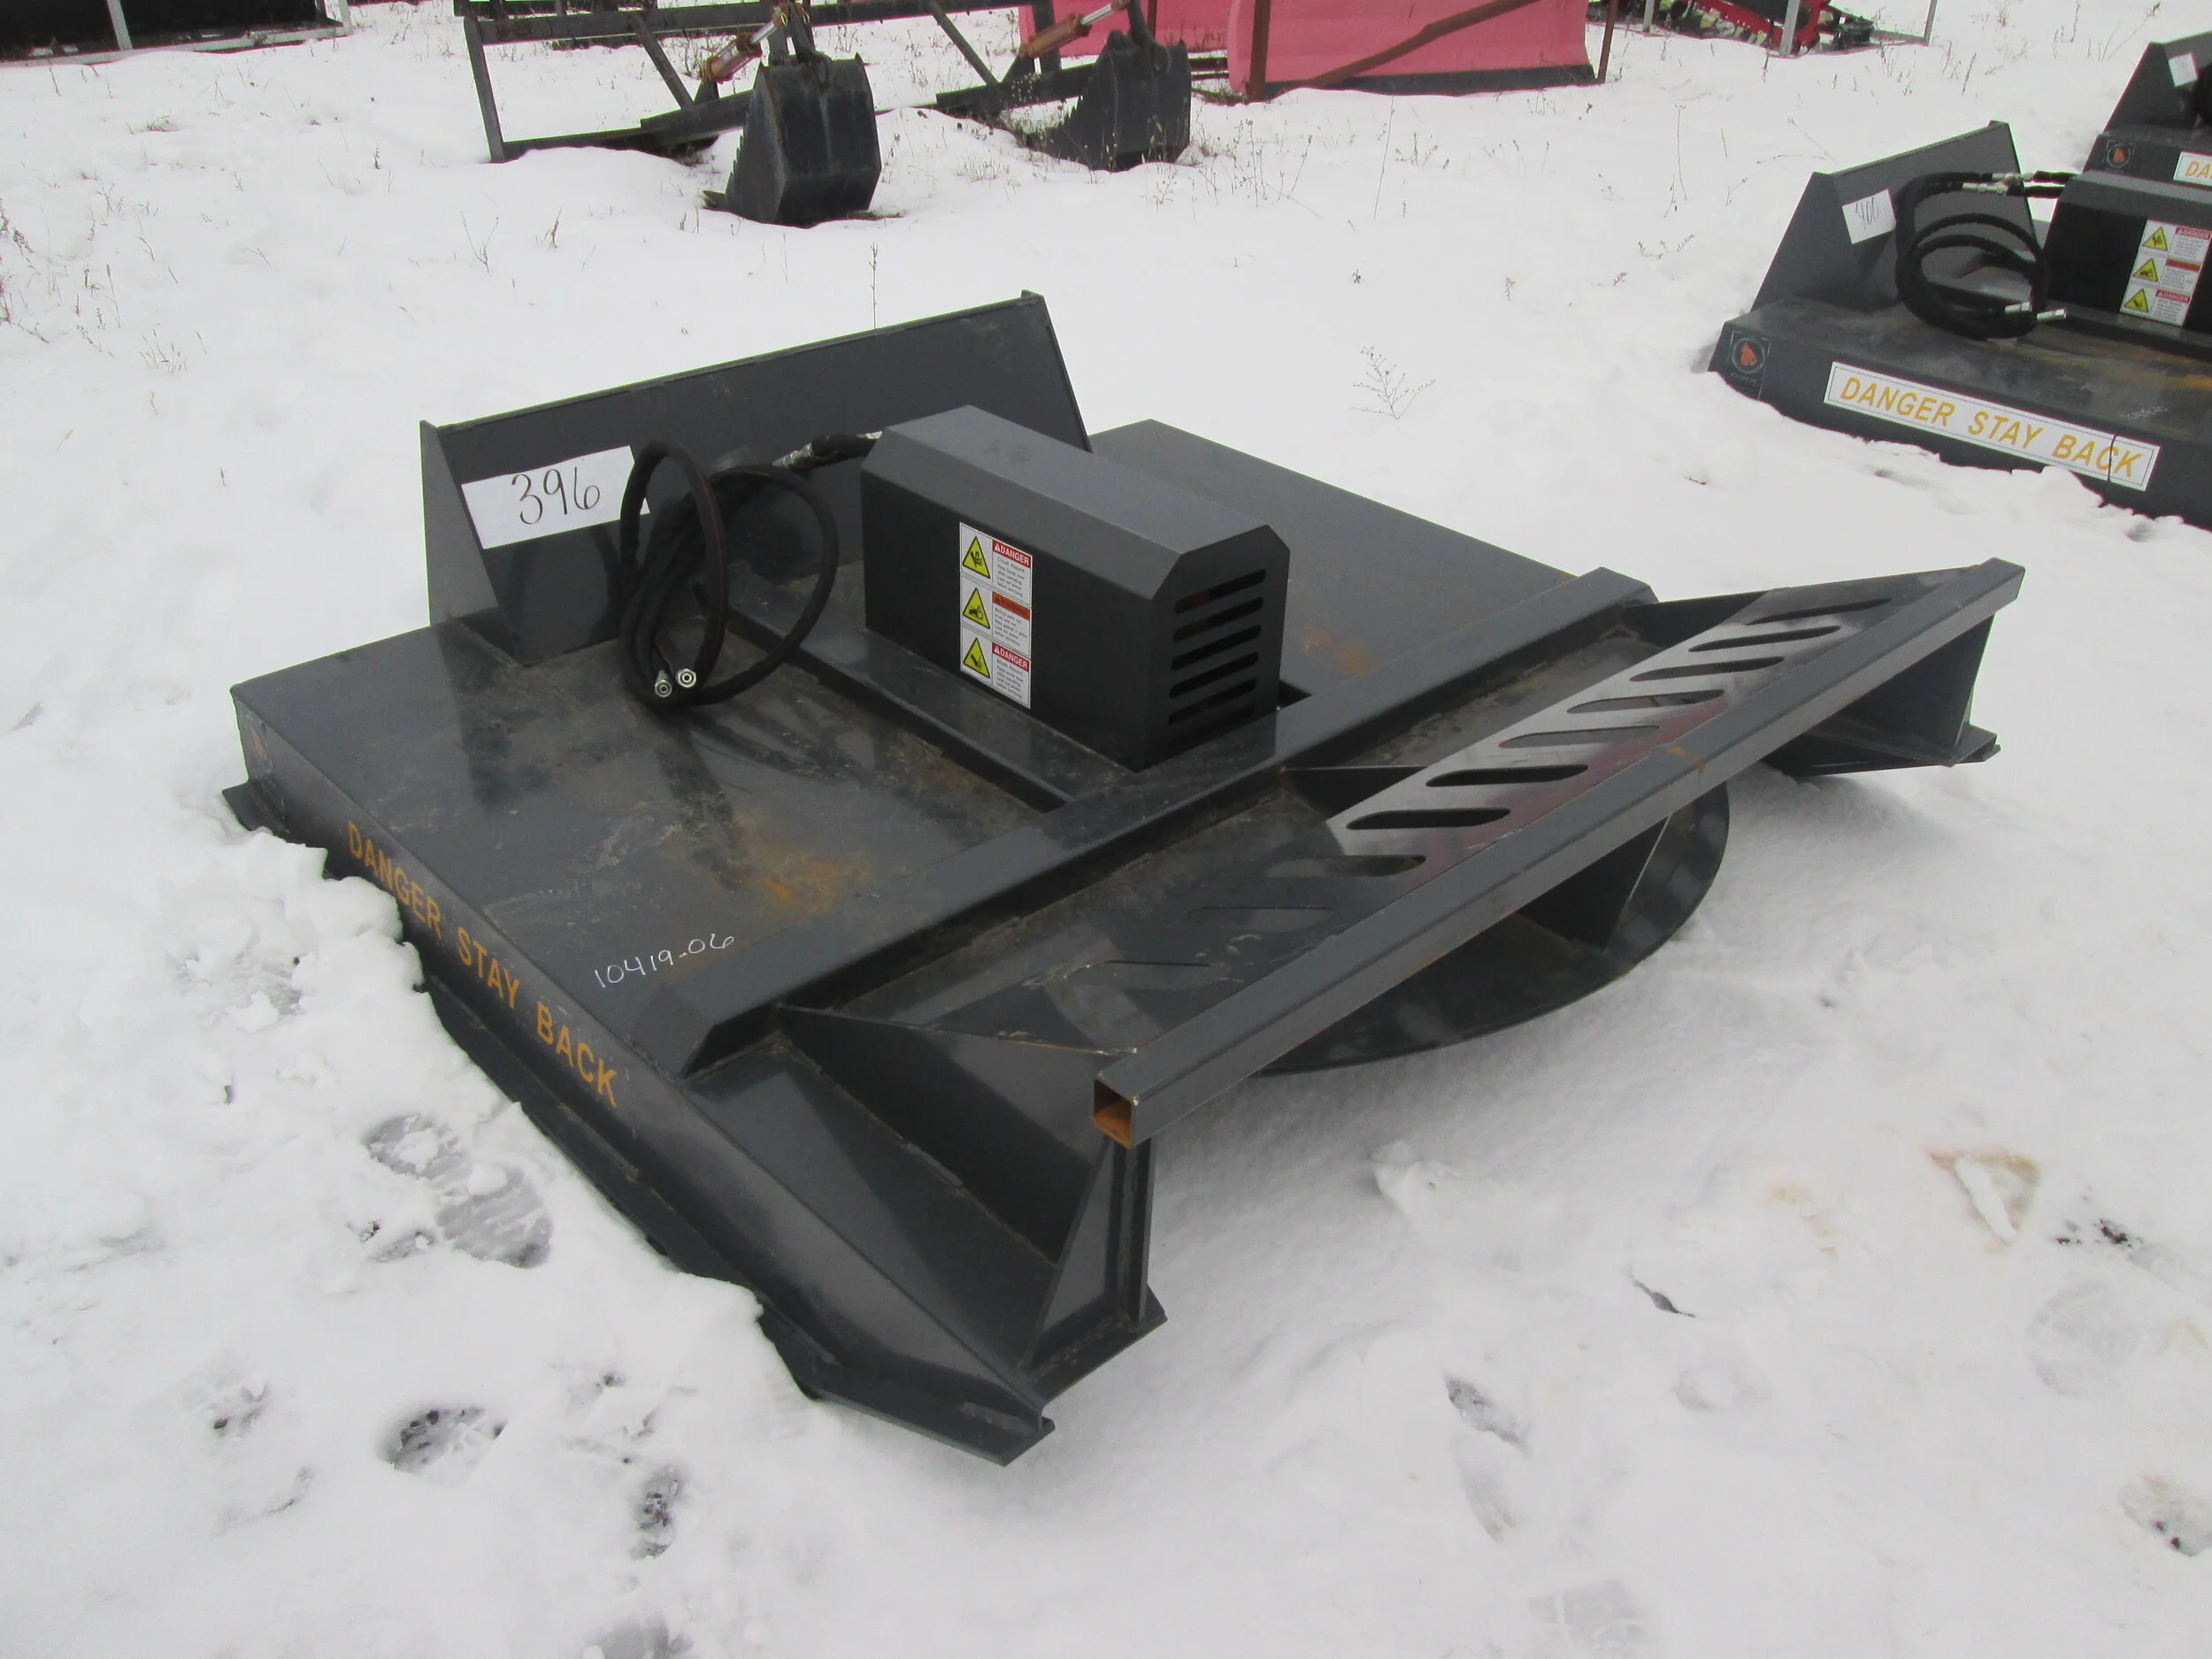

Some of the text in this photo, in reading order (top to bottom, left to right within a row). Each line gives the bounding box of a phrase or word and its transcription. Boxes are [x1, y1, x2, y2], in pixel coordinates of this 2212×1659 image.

[1839, 376, 2145, 478] DANGER STAY BACK
[511, 466, 601, 525] 396
[1001, 546, 1030, 566] DANGER
[1000, 649, 1028, 670] DANGER
[348, 820, 617, 1108] DANGER STAY BACK
[594, 933, 734, 988] 10419-06
